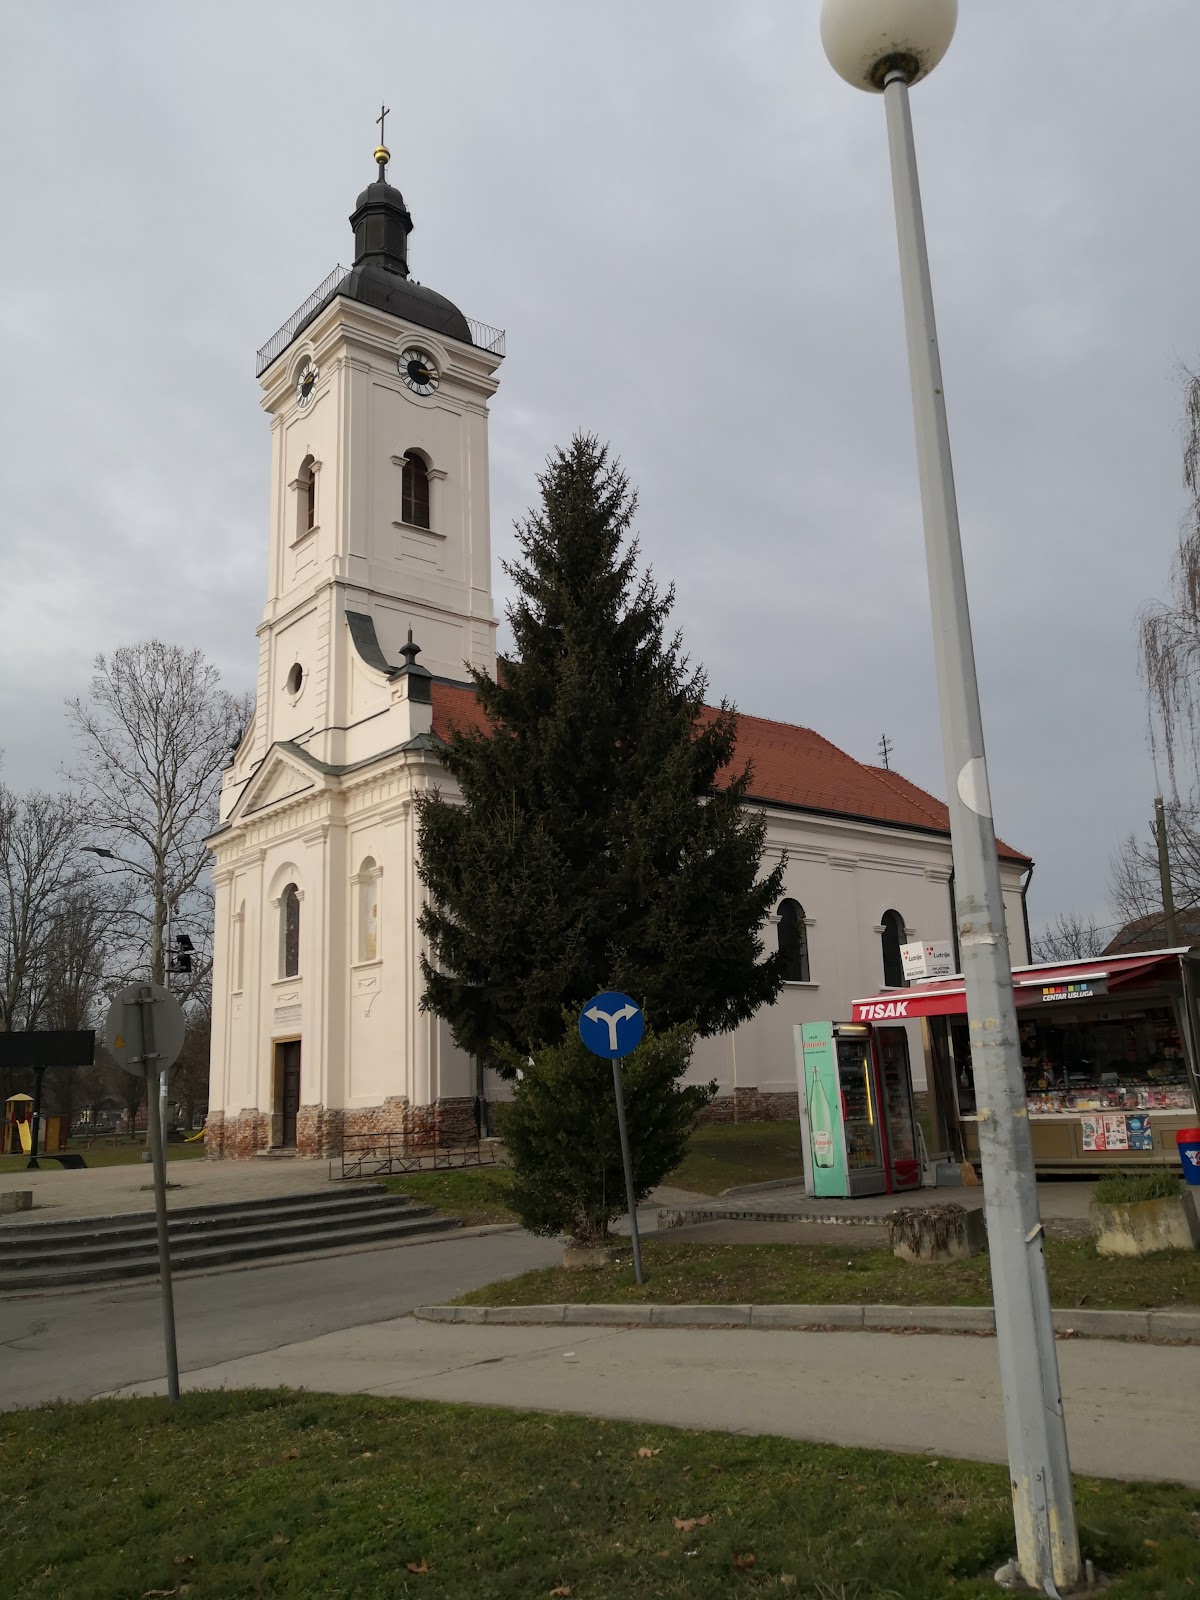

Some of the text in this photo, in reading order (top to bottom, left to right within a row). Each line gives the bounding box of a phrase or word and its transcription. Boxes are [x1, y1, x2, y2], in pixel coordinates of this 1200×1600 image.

[1043, 991, 1093, 1001] CENTAR USLUGA
[859, 1001, 908, 1019] TISAK
